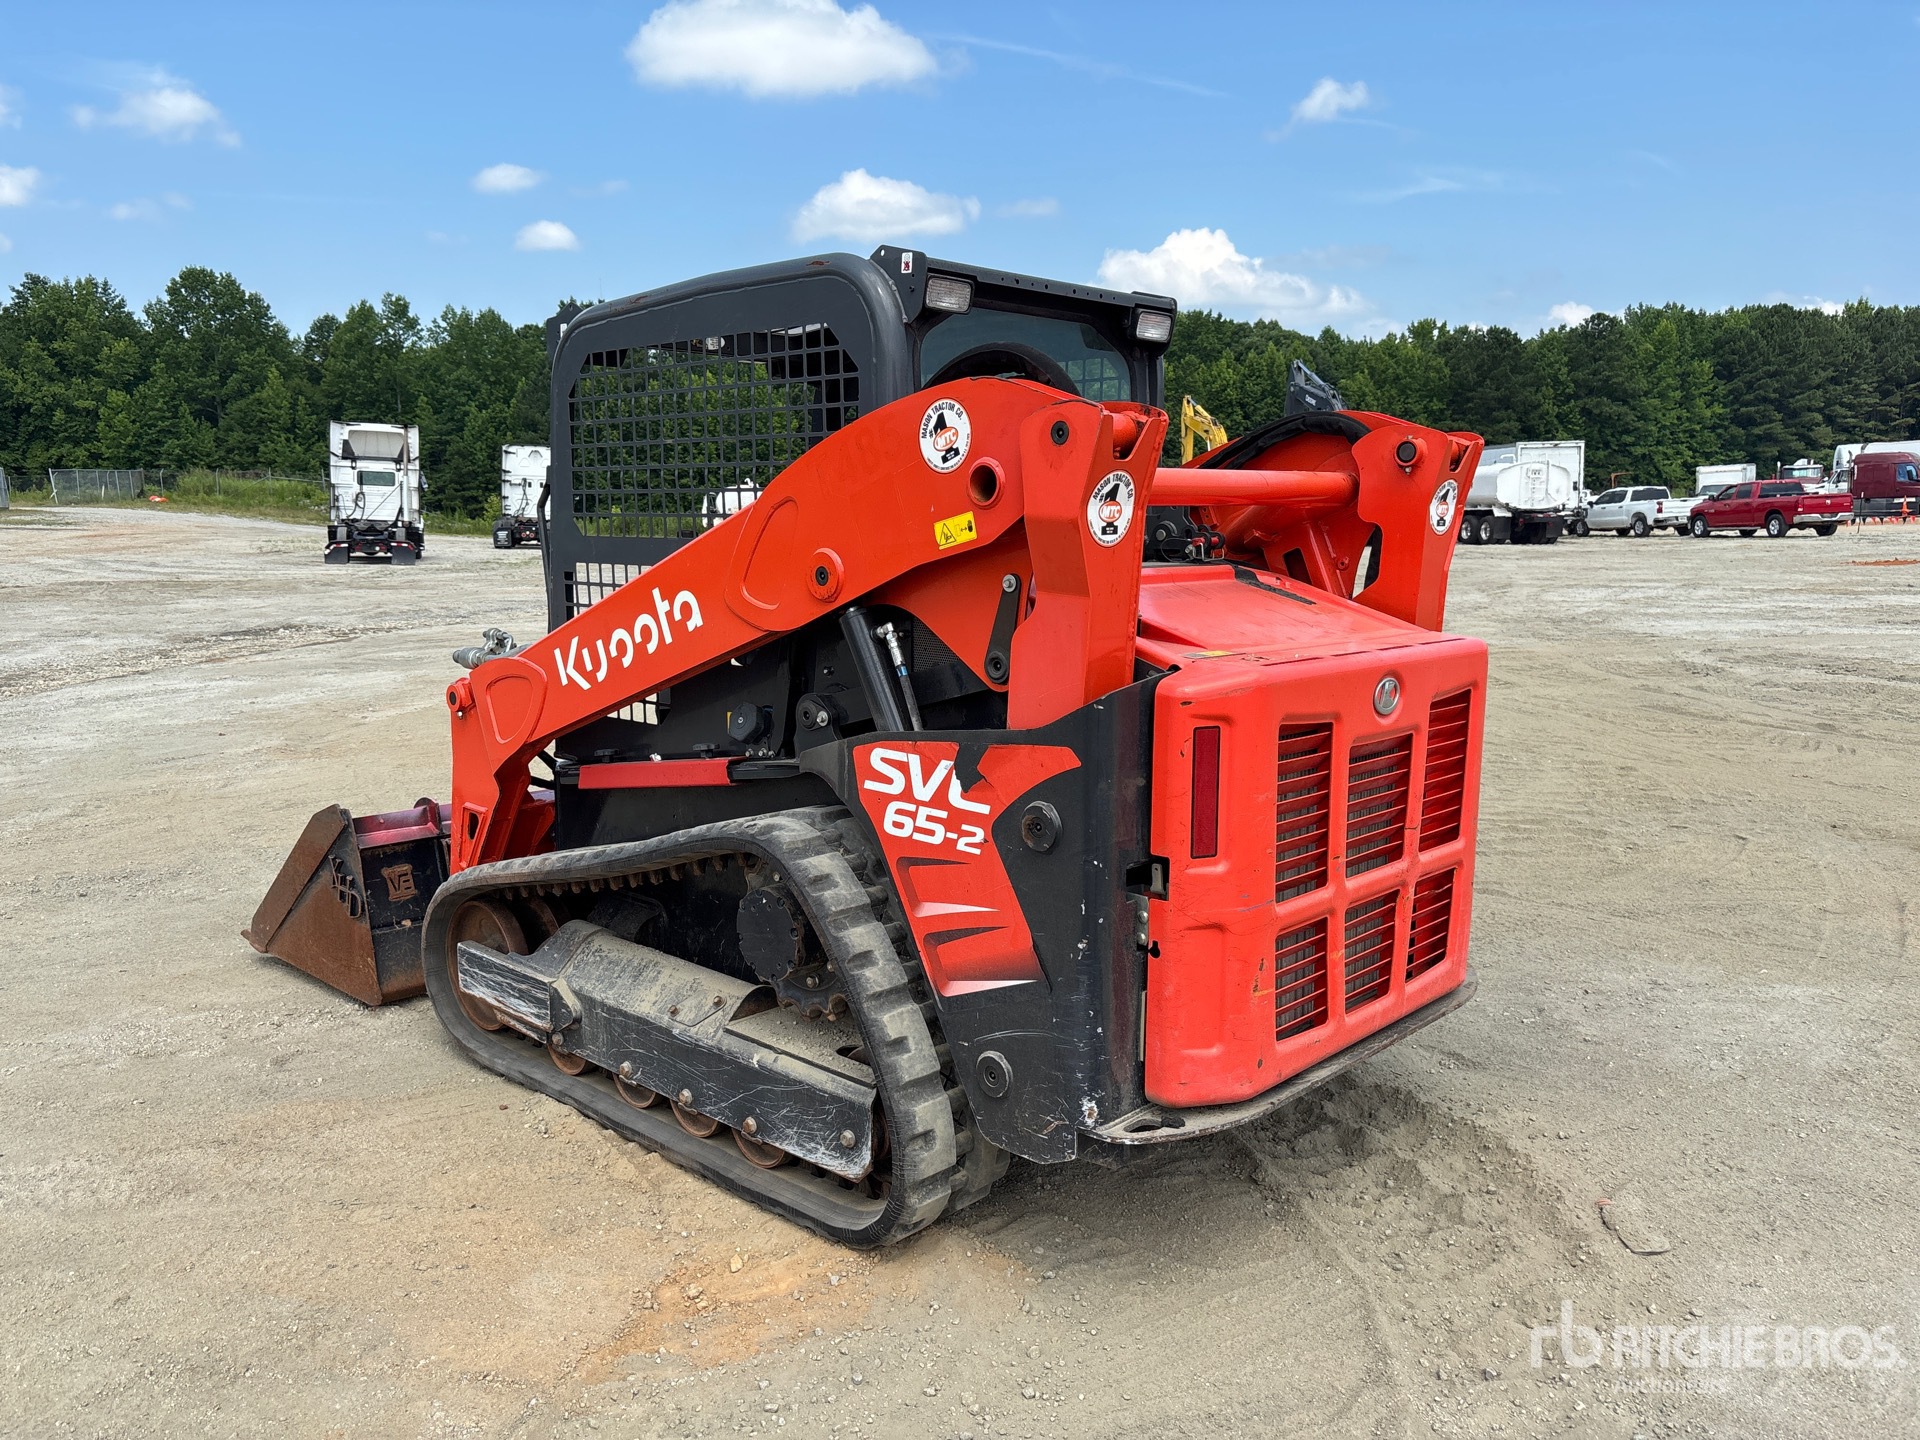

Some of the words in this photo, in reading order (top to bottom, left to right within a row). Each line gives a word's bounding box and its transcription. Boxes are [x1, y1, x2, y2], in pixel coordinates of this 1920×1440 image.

[921, 412, 933, 439] MASON
[931, 401, 955, 416] TRACTOR
[955, 407, 964, 420] CO.
[936, 428, 957, 448] MTC
[1092, 476, 1111, 500] MASON
[1112, 473, 1132, 489] TRACTOR
[1101, 505, 1121, 518] MTC
[553, 586, 704, 691] Kubota
[863, 747, 992, 815] SVL
[883, 800, 985, 856] 65-2
